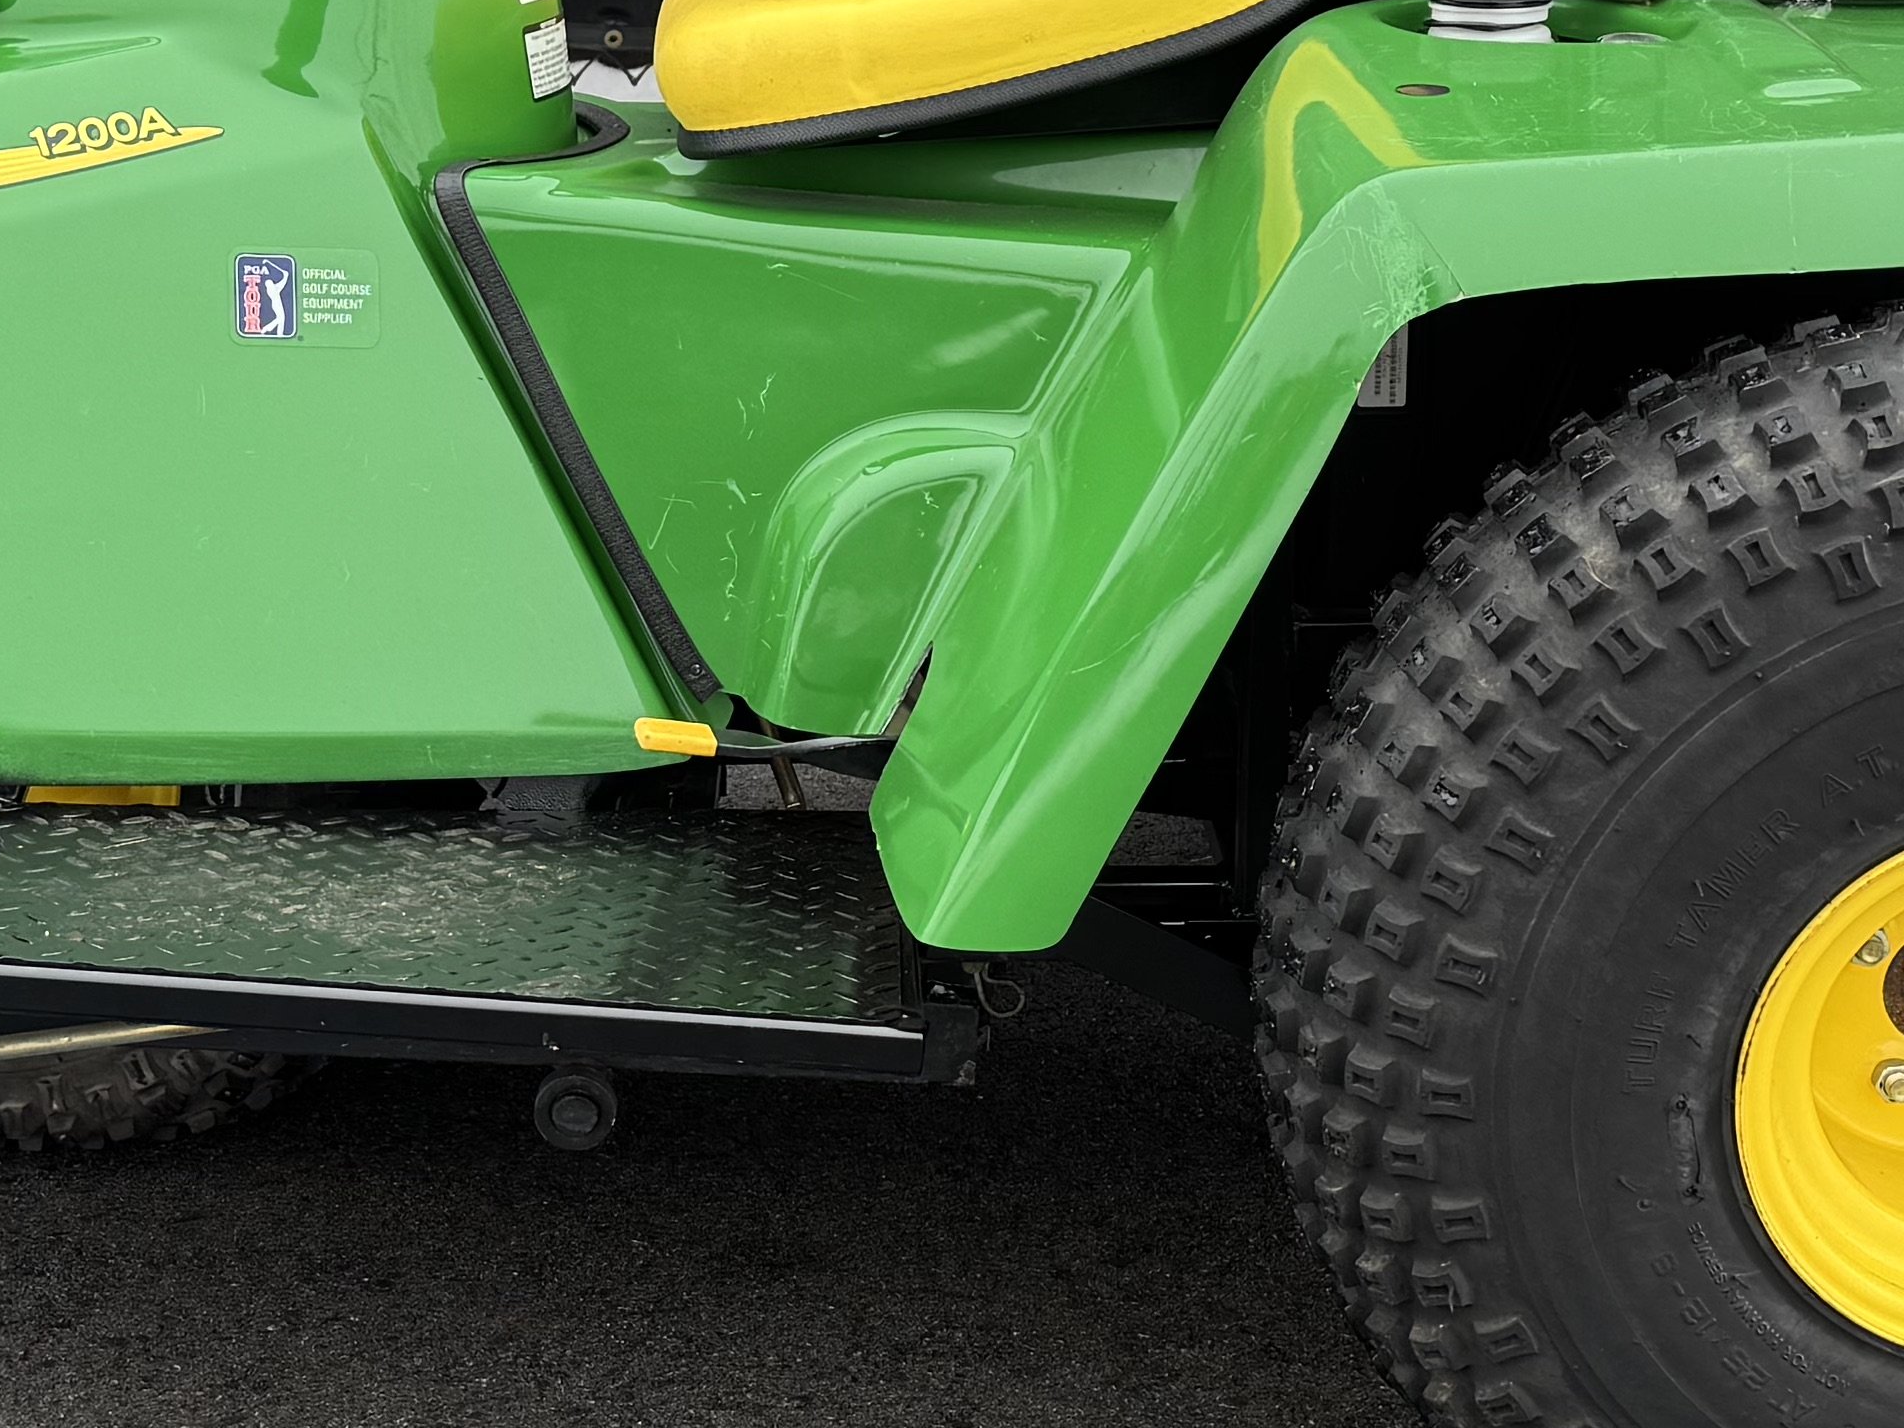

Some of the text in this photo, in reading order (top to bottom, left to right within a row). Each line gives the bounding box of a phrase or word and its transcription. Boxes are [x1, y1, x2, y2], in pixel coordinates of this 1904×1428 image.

[28, 105, 182, 159] 1200A
[243, 265, 270, 275] PGA
[302, 268, 347, 280] OFFICIAL
[302, 283, 372, 296] GOLF COURSE
[243, 274, 262, 333] TOUR
[302, 297, 364, 310] EQUIPMENT
[302, 312, 353, 325] SUPPLIER
[1621, 970, 1676, 1097] TURF
[1665, 808, 1800, 949] TAMER
[1686, 1220, 1730, 1286] SERVICE
[1781, 1344, 1813, 1375] FOR
